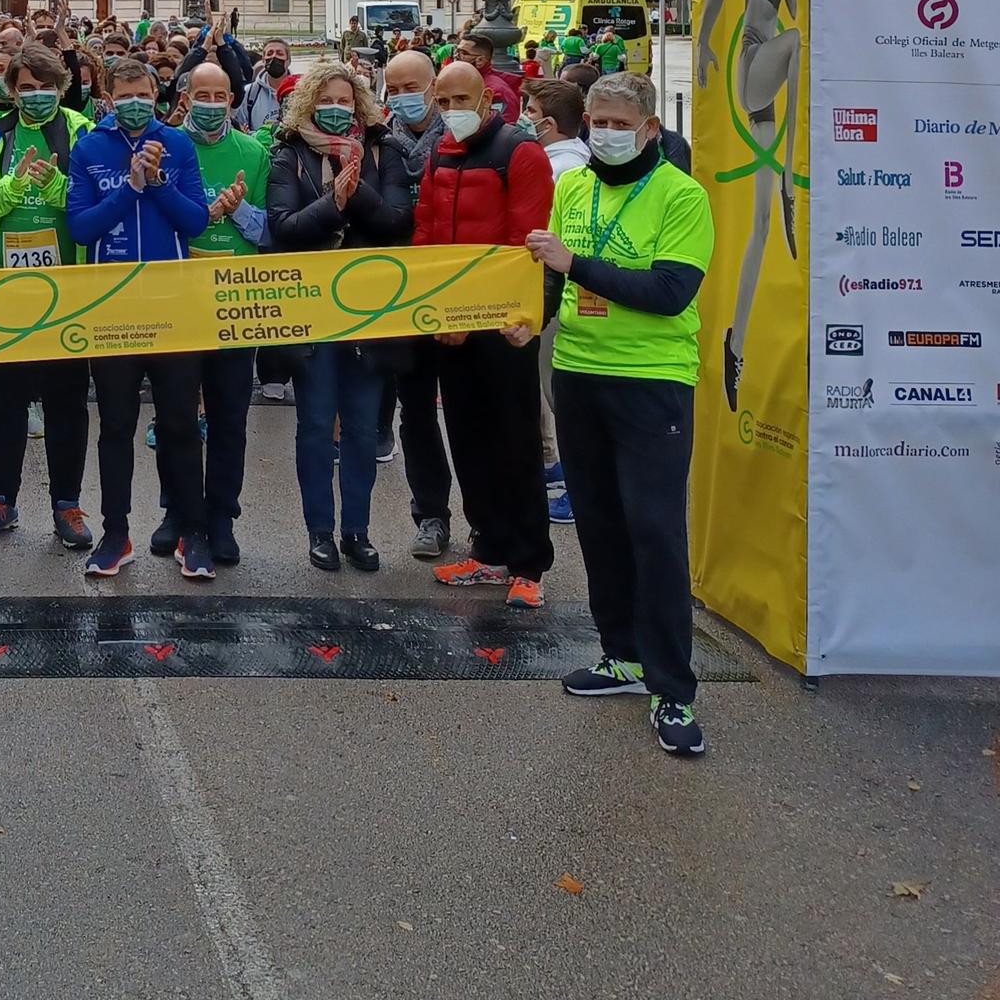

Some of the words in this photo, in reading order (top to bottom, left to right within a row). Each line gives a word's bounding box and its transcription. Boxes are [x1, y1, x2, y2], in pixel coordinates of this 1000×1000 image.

[913, 36, 947, 46] Oficial
[952, 38, 965, 47] de
[930, 49, 964, 59] Balears
[835, 126, 864, 140] Hora
[915, 119, 960, 133] Diario
[965, 120, 986, 134] de
[838, 168, 865, 185] Salut
[873, 170, 911, 189] Força
[883, 227, 922, 246] Balear
[11, 250, 52, 267] 2136
[215, 267, 302, 284] Mallorca
[215, 288, 240, 302] en
[246, 282, 321, 301] marcha
[216, 303, 281, 321] contra
[218, 324, 238, 340] el
[242, 322, 312, 340] cáncer
[827, 385, 862, 397] RADIO
